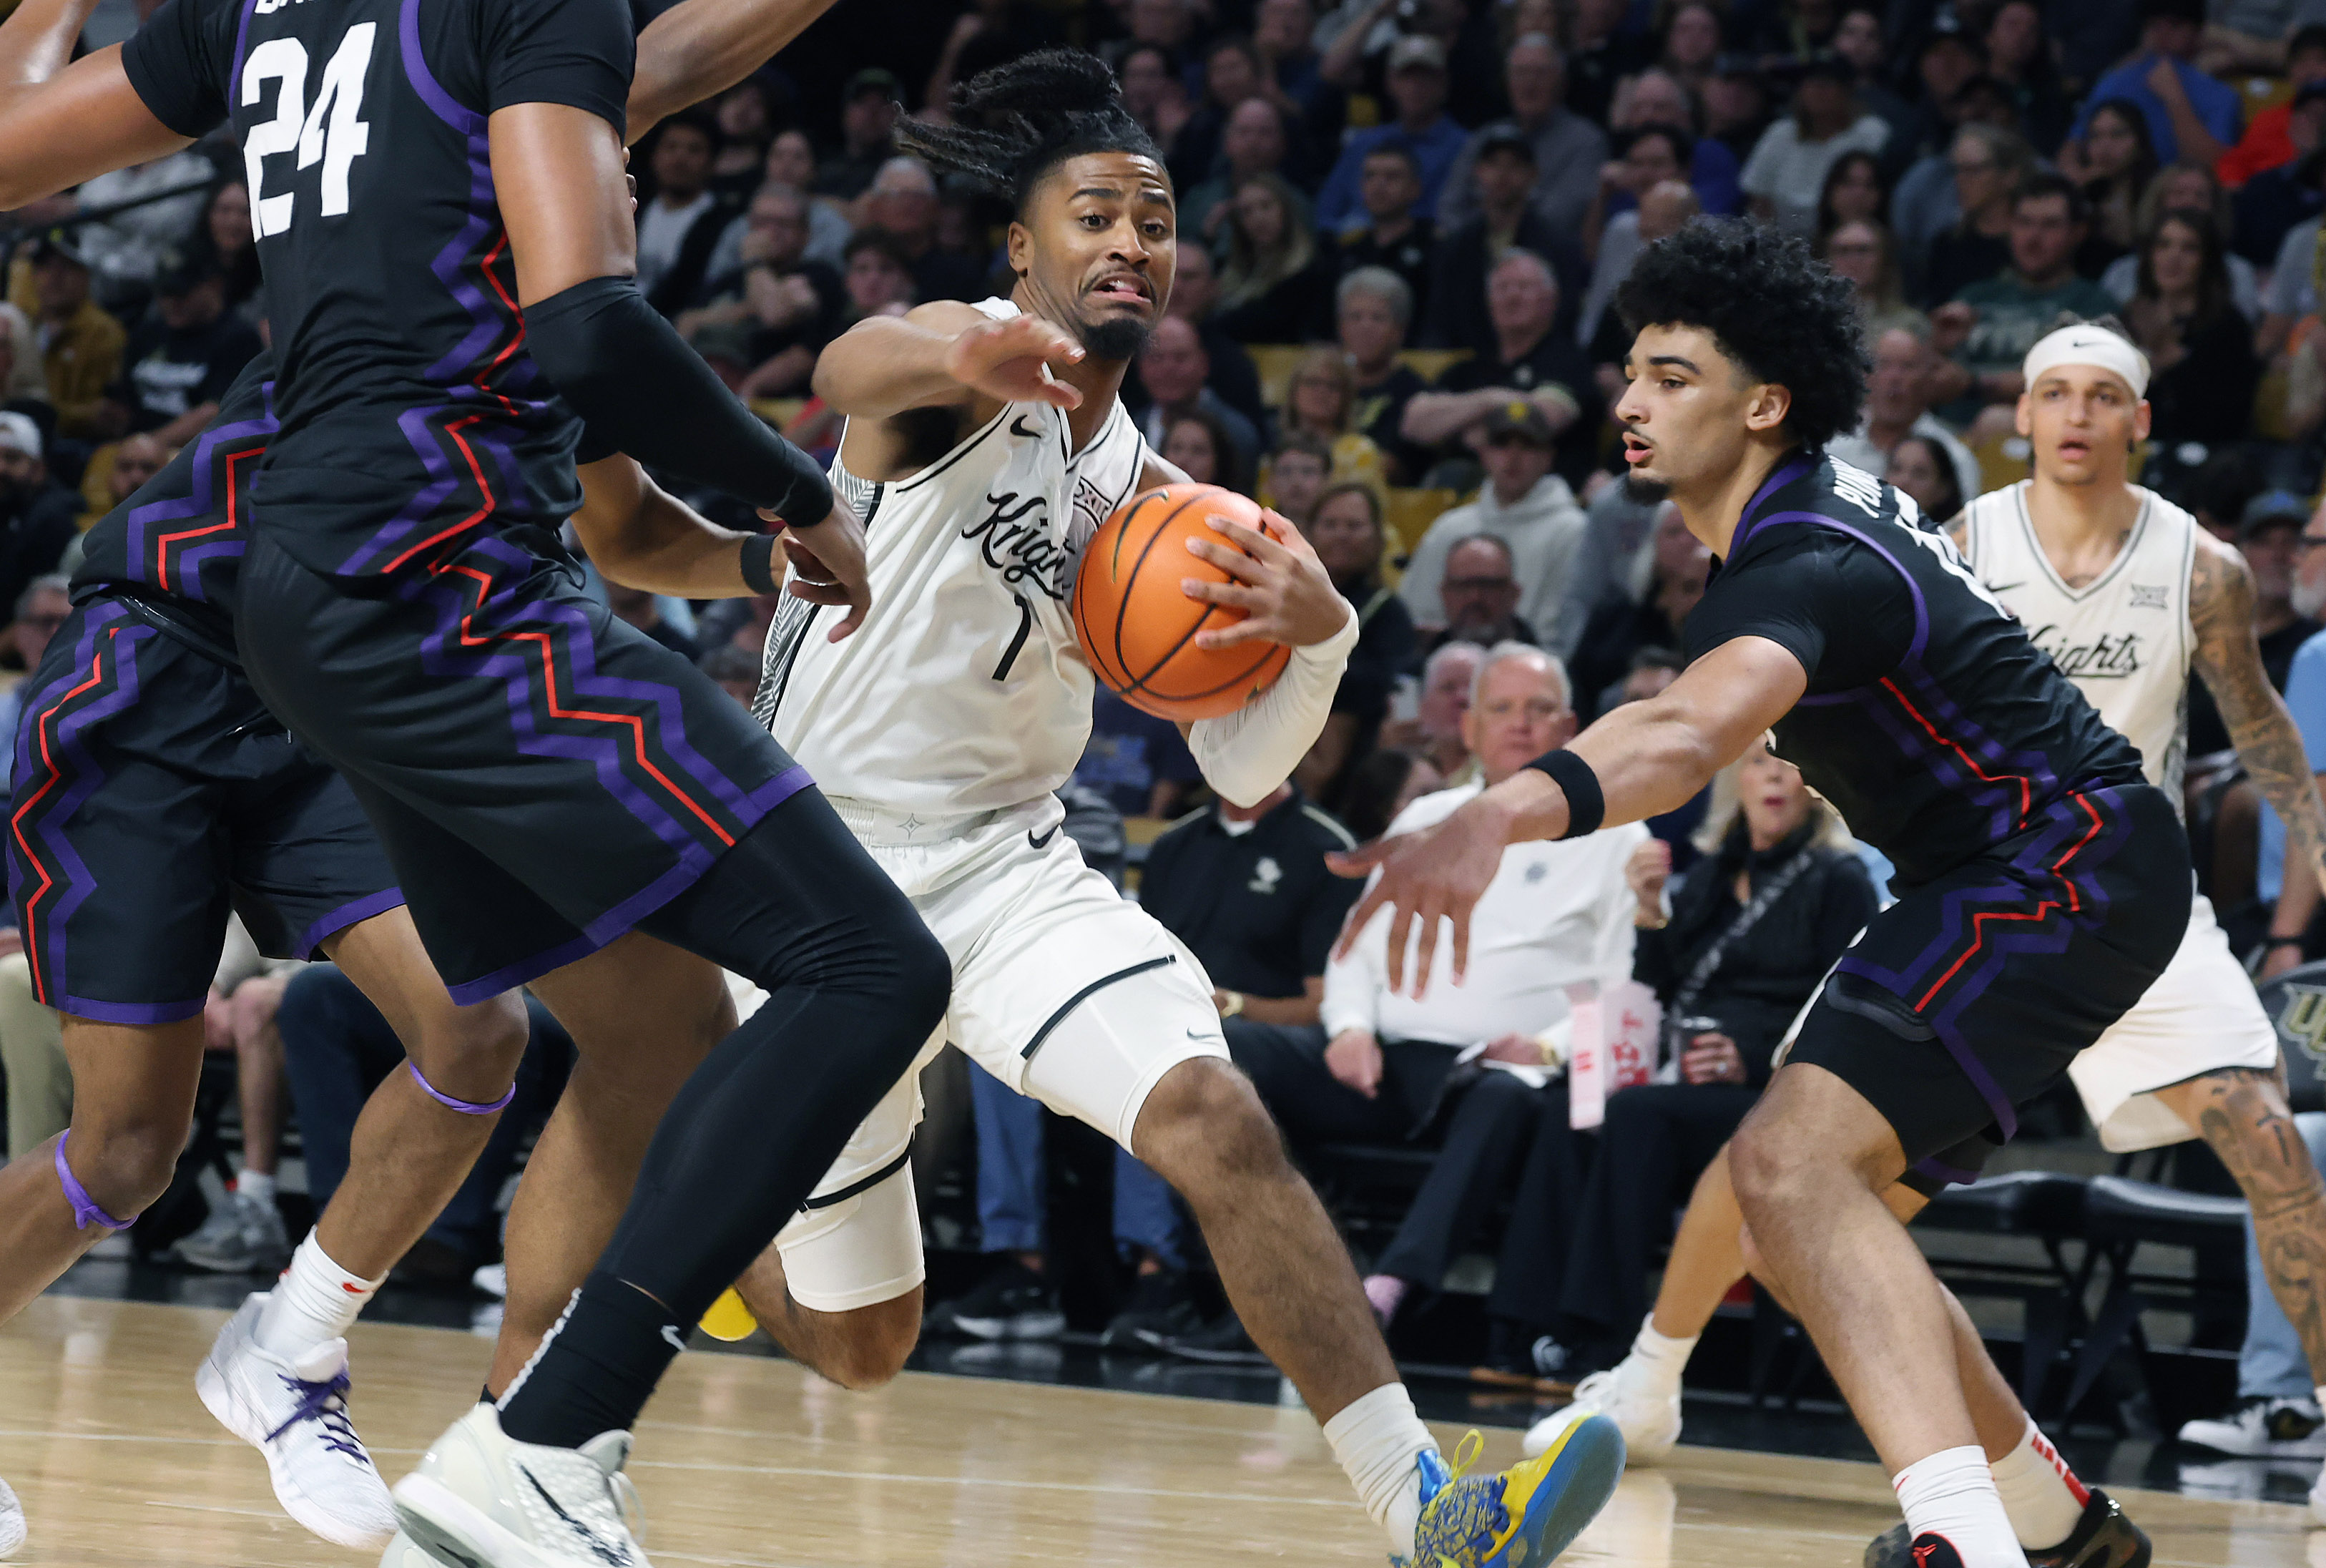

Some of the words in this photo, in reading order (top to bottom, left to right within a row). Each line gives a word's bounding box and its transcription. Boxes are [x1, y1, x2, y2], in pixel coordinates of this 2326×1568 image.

[241, 21, 377, 243] 24
[991, 594, 1032, 682] 1
[2030, 623, 2144, 678] ights
